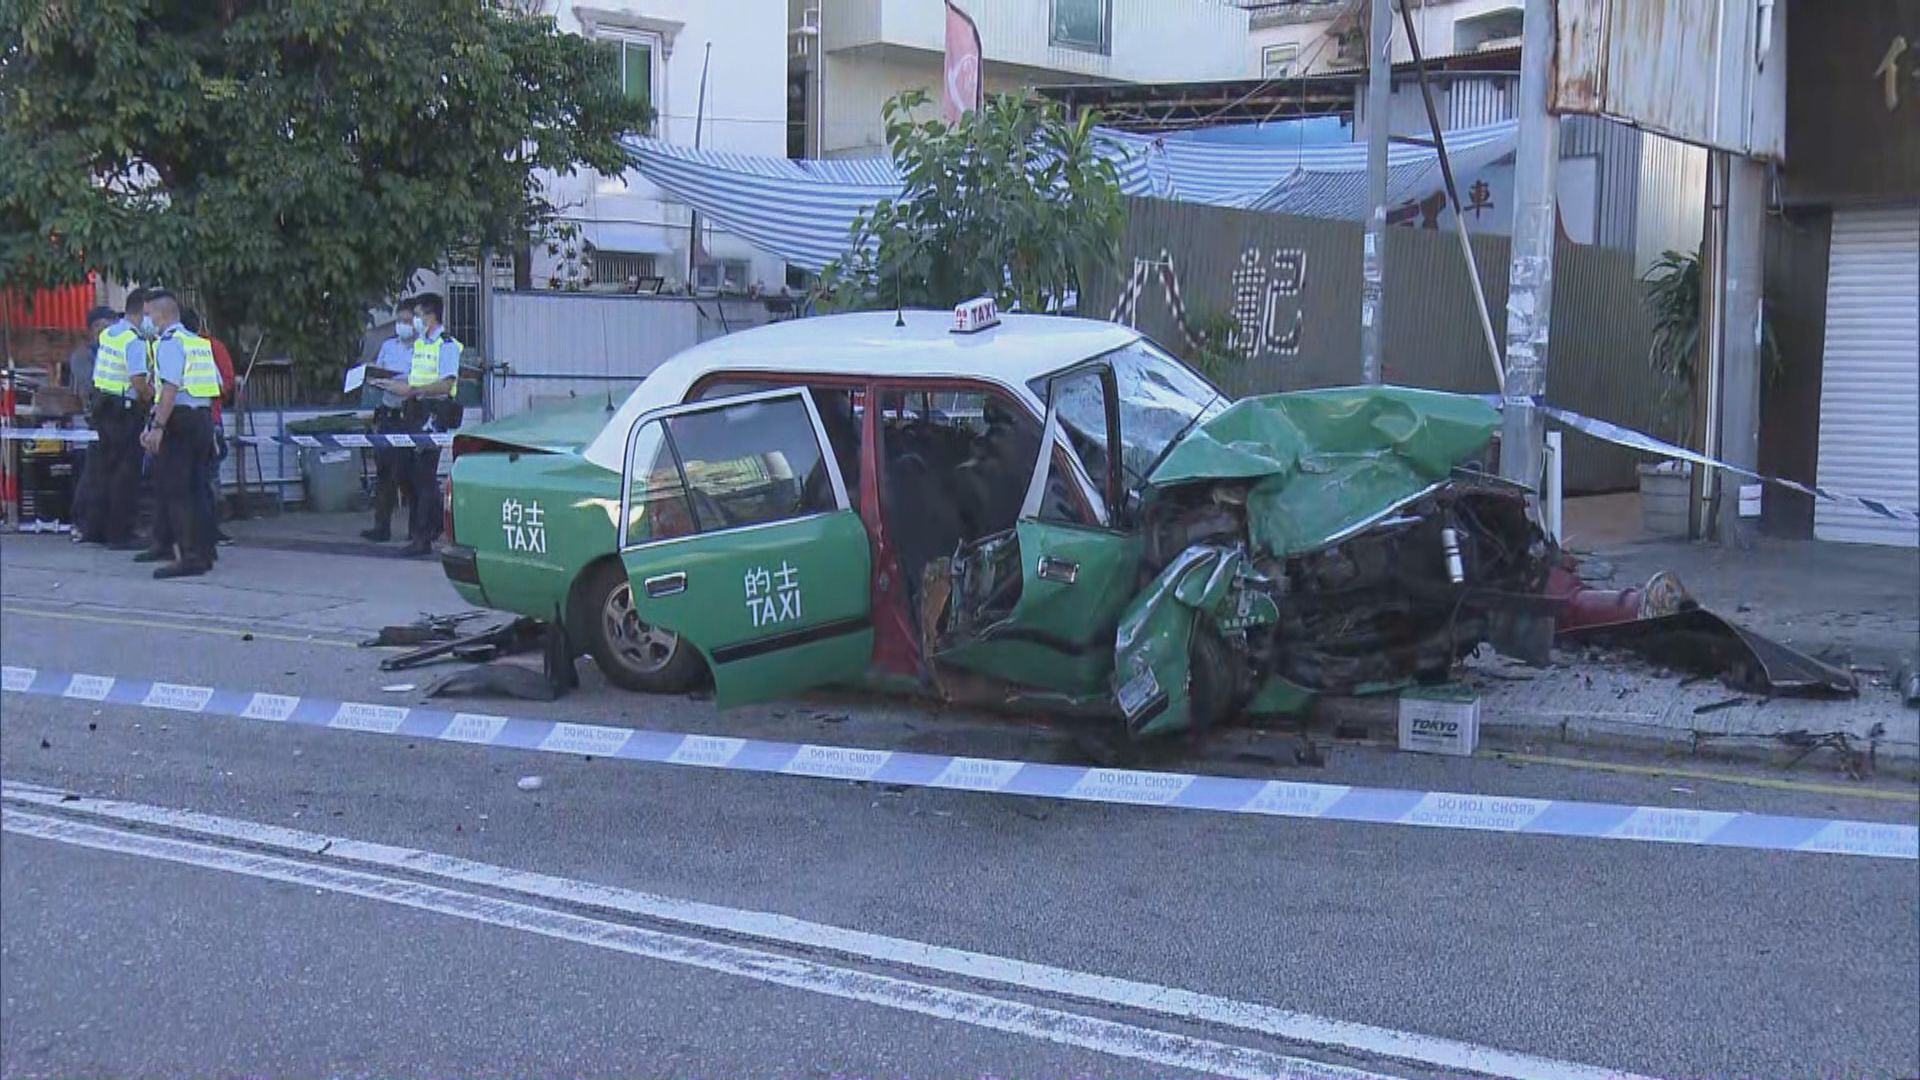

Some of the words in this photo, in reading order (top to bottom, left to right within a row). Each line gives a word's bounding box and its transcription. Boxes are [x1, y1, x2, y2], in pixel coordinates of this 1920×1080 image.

[971, 302, 997, 325] TAXI
[502, 498, 545, 527] 的士
[502, 524, 546, 554] TAXI
[744, 560, 798, 599] 的士
[745, 589, 801, 627] TAXI
[1412, 719, 1458, 732] TOKYO
